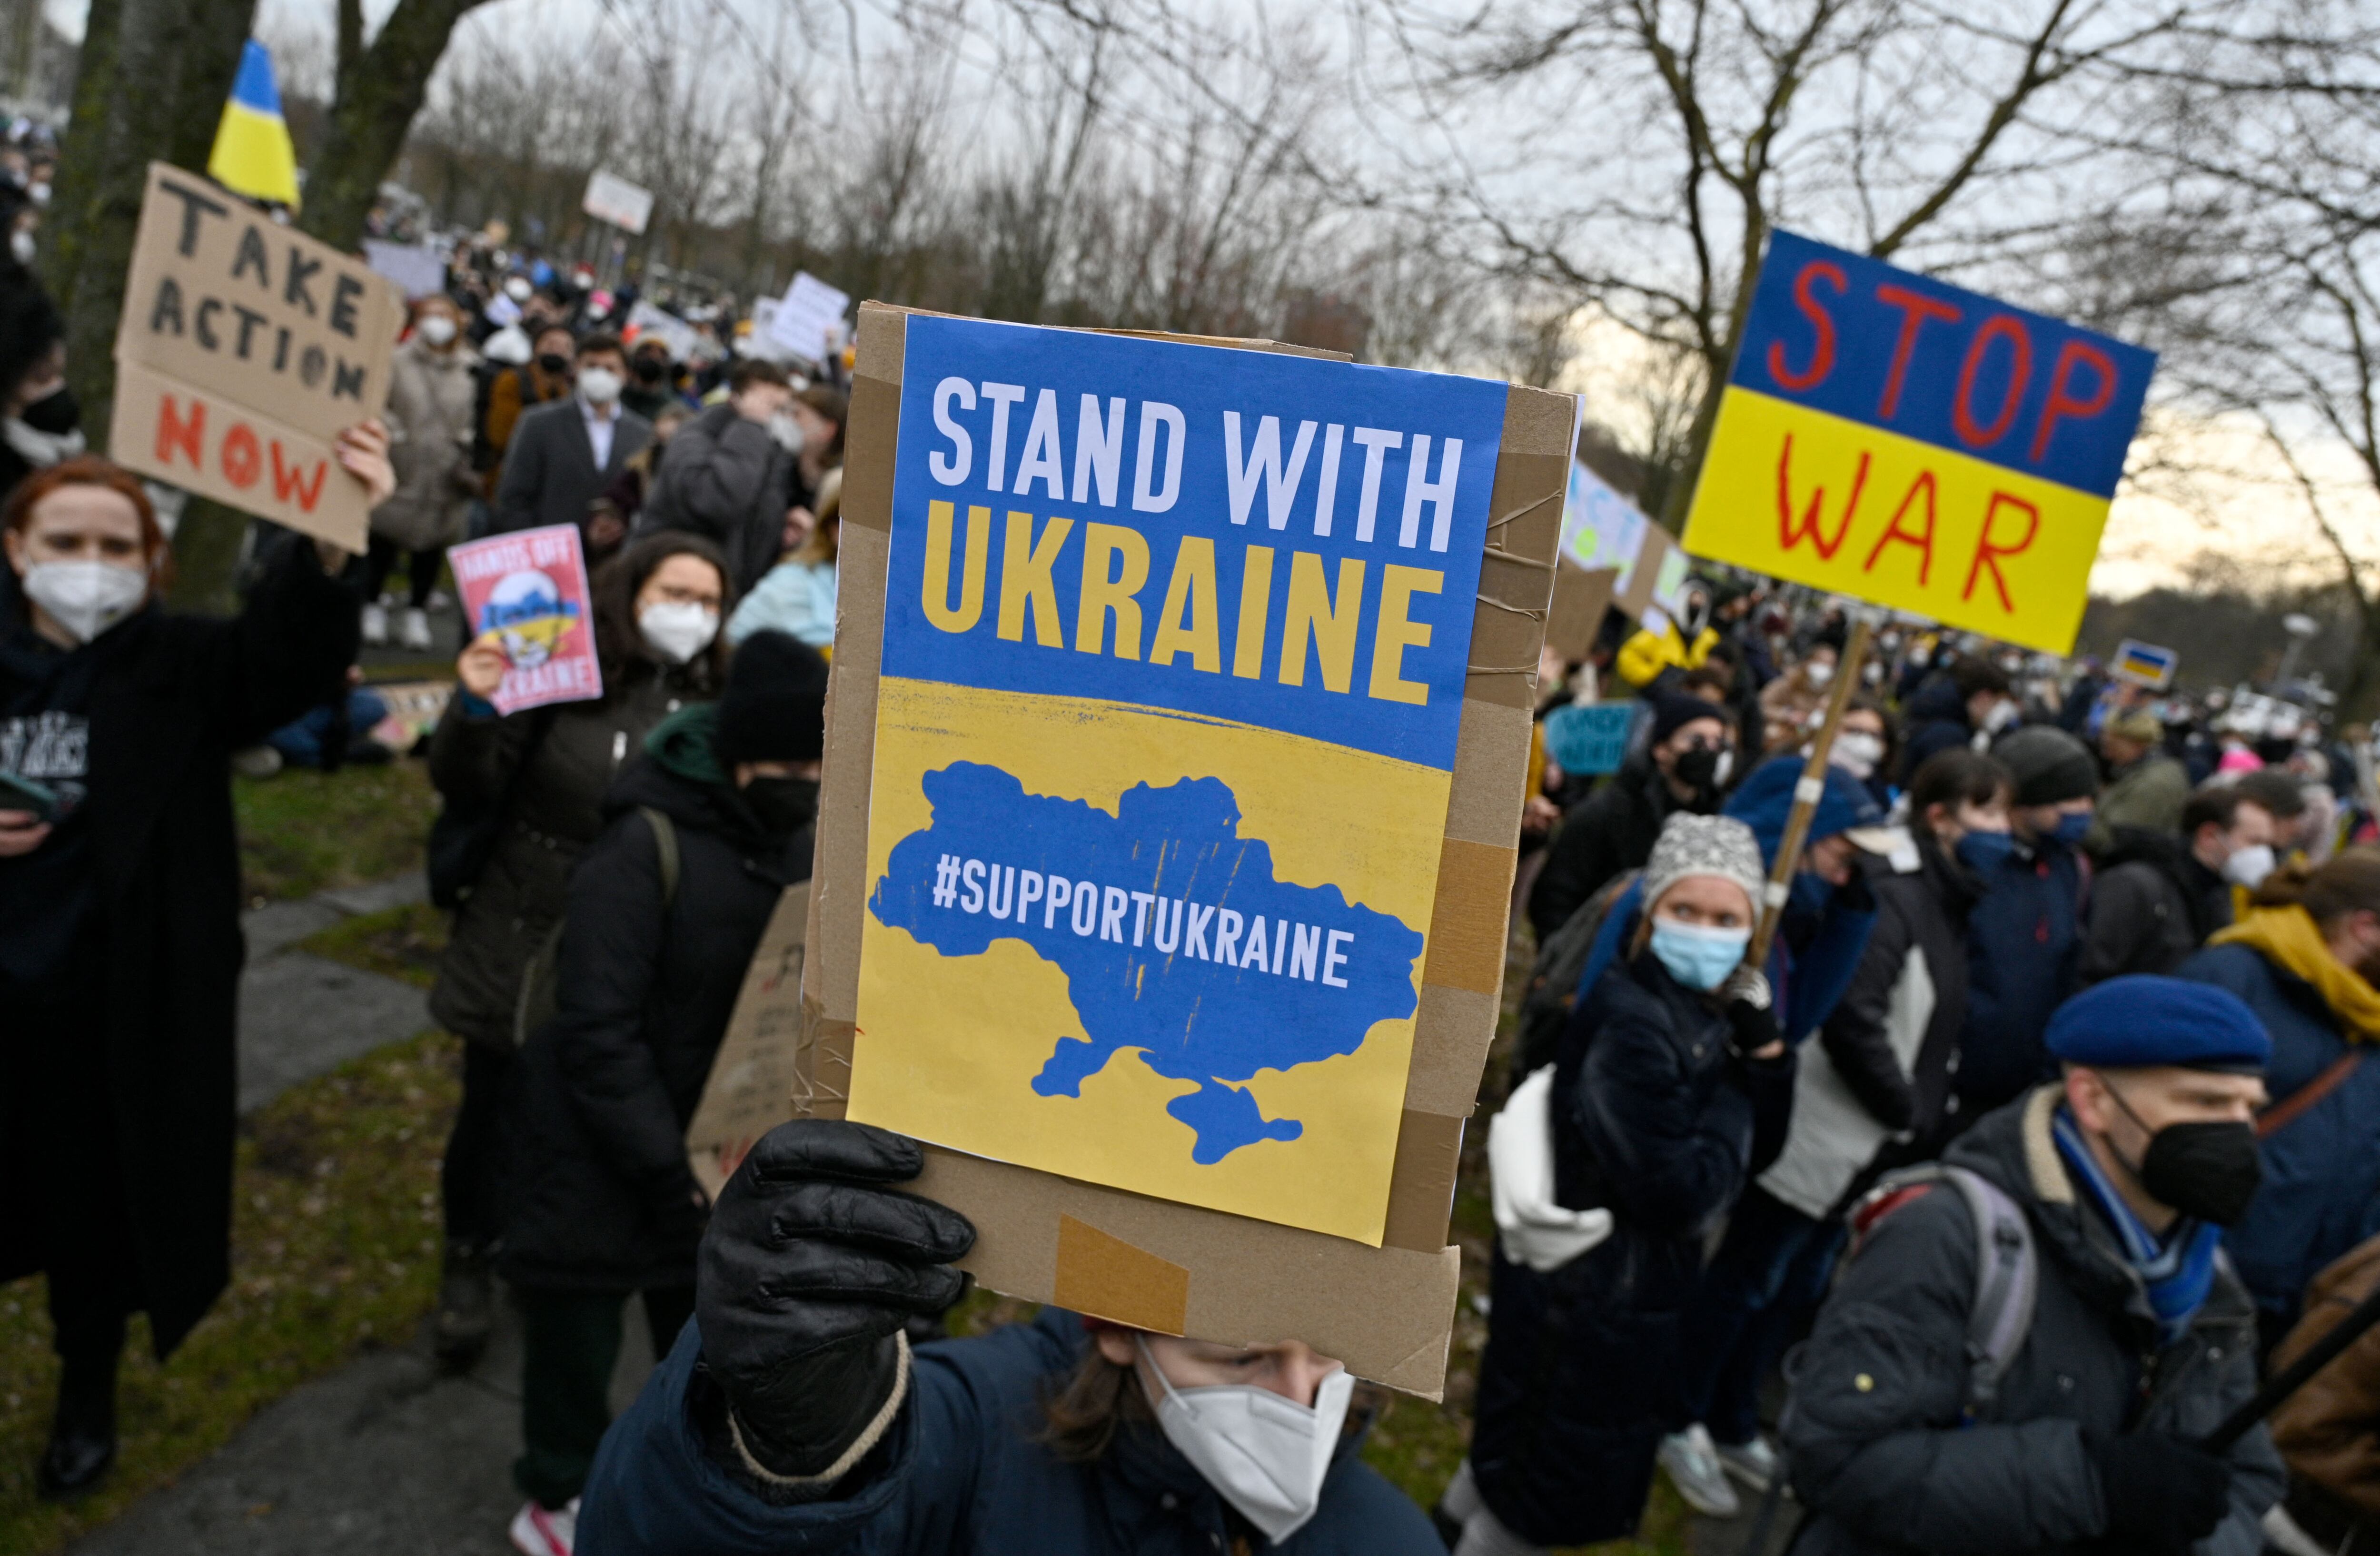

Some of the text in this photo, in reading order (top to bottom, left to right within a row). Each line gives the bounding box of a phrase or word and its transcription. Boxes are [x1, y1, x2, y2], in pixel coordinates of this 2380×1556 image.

[150, 278, 366, 403] ACTION
[159, 177, 365, 339] TAKE
[1766, 260, 2118, 463] STOP
[155, 391, 328, 513] NOW
[929, 377, 1186, 514] STAND
[1223, 411, 1463, 553] WITH
[1776, 432, 2040, 614] WAR
[922, 499, 1444, 706] UKRAINE
[933, 854, 1354, 988] #SUPPORTUKRAINE
